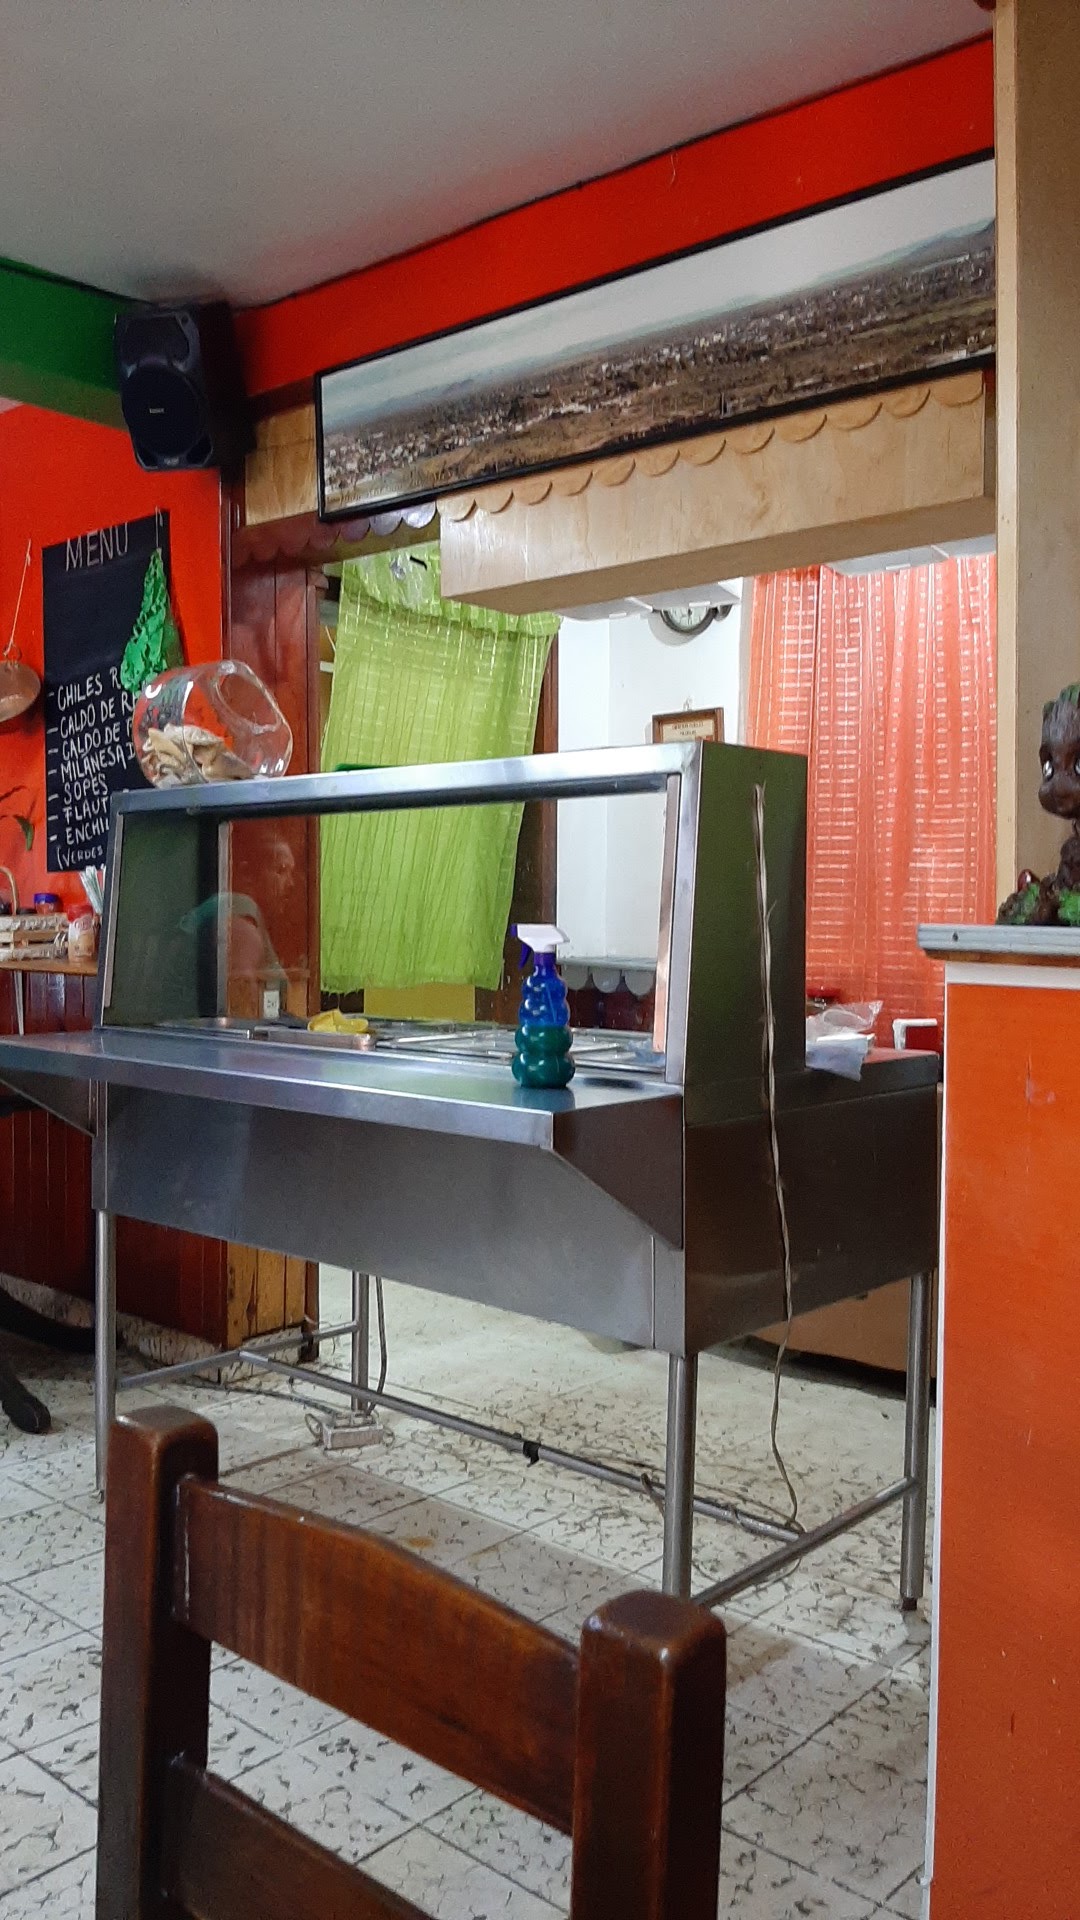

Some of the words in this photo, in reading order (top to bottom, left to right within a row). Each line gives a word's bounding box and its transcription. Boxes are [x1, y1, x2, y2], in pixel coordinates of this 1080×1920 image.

[66, 521, 128, 572] MENU
[58, 672, 103, 711] CHILES
[109, 666, 121, 690] R
[60, 703, 96, 739] CALDO
[101, 697, 116, 723] DE
[62, 728, 101, 760] CALDO
[104, 722, 121, 745] DE
[61, 744, 127, 783] MILANESA
[63, 773, 108, 805] SOPES
[62, 796, 109, 825] FLAUT
[65, 817, 110, 845] ENCHIL
